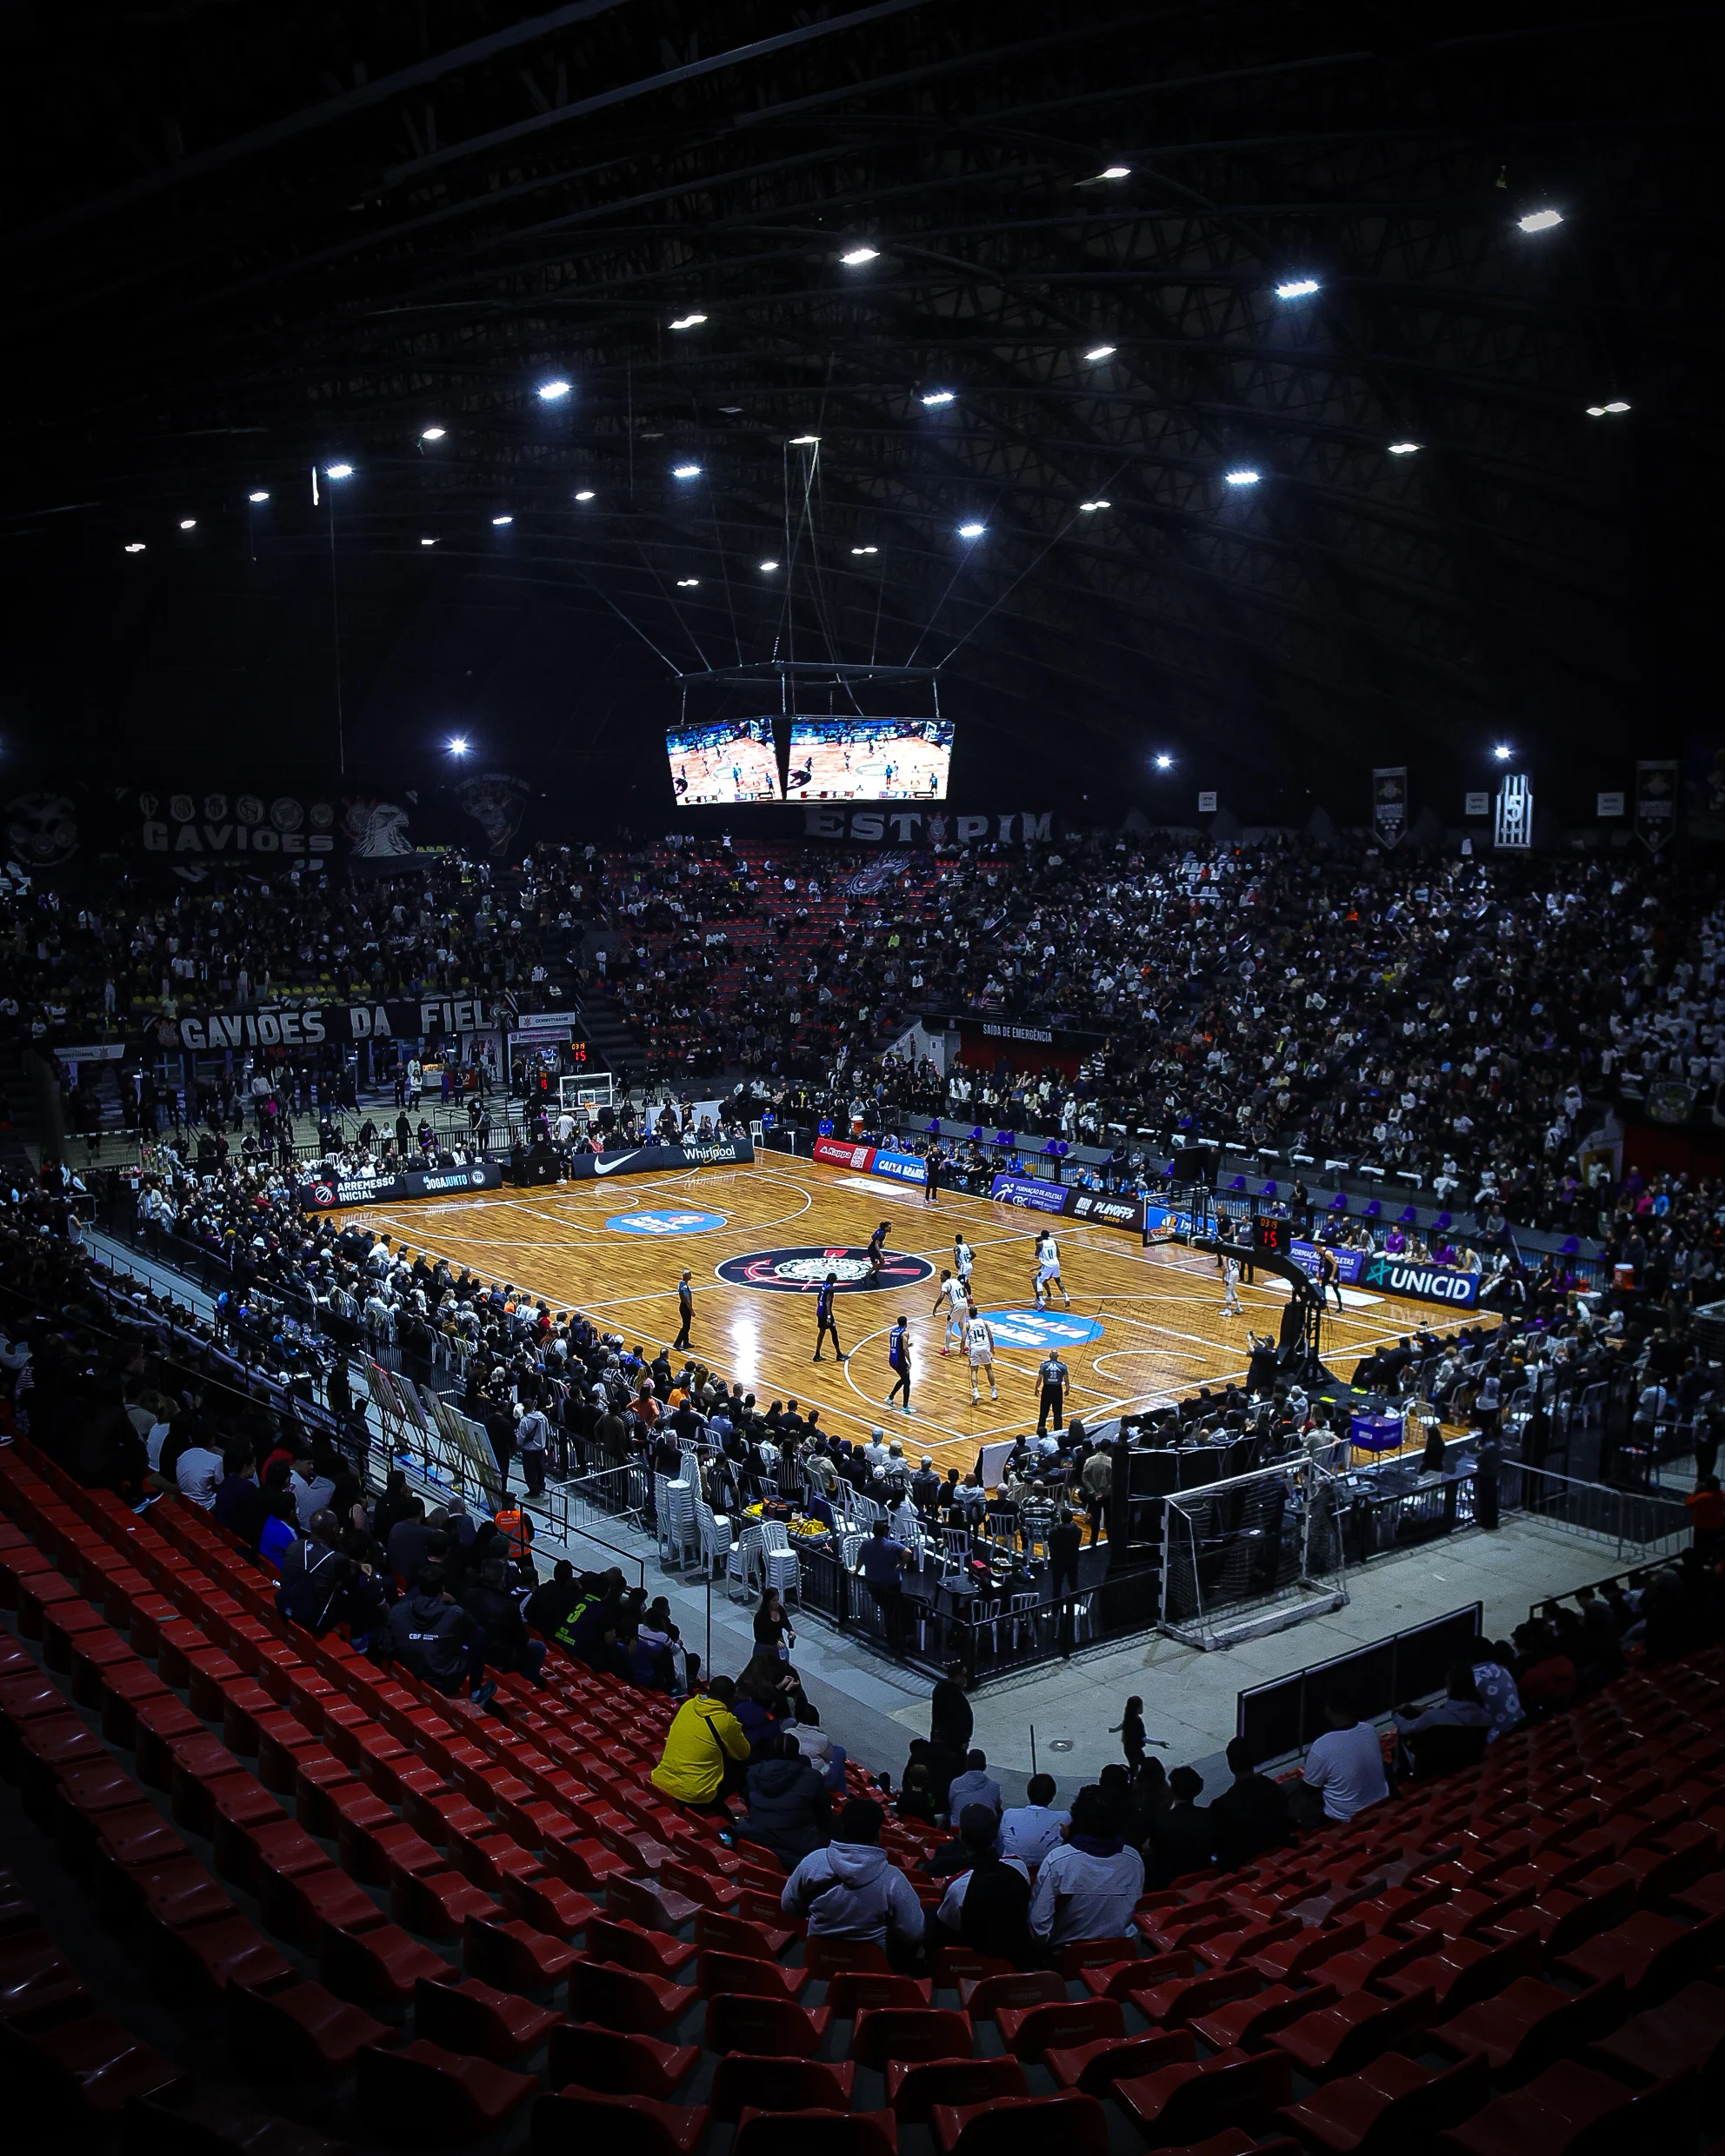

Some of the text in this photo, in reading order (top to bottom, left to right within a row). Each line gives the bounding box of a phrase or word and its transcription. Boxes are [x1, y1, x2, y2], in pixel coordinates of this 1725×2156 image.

[143, 821, 334, 853] GAVIÕES
[180, 1000, 492, 1049] GAVIÕES DA FIEL
[982, 1023, 1053, 1043] SAÍDA DE EMERGÊNCIA
[683, 1145, 736, 1161] Whirlpool
[828, 1147, 851, 1159] Kappa
[878, 1160, 902, 1174] CAIXA
[902, 1166, 925, 1180] BRASIL
[337, 1175, 395, 1192] ARREMESSO
[423, 1174, 467, 1189] #JOGAJUNTO
[339, 1190, 376, 1202] INICIAL
[1016, 1186, 1039, 1194] FORMAÇÃO
[1045, 1191, 1062, 1200] ATLETAS
[1093, 1201, 1135, 1219] PLAYOFFS
[1263, 1230, 1277, 1248] 15
[1391, 1267, 1471, 1300] UNICID
[891, 1336, 897, 1348] 11
[973, 1328, 985, 1343] 14
[567, 1603, 587, 1623] 3
